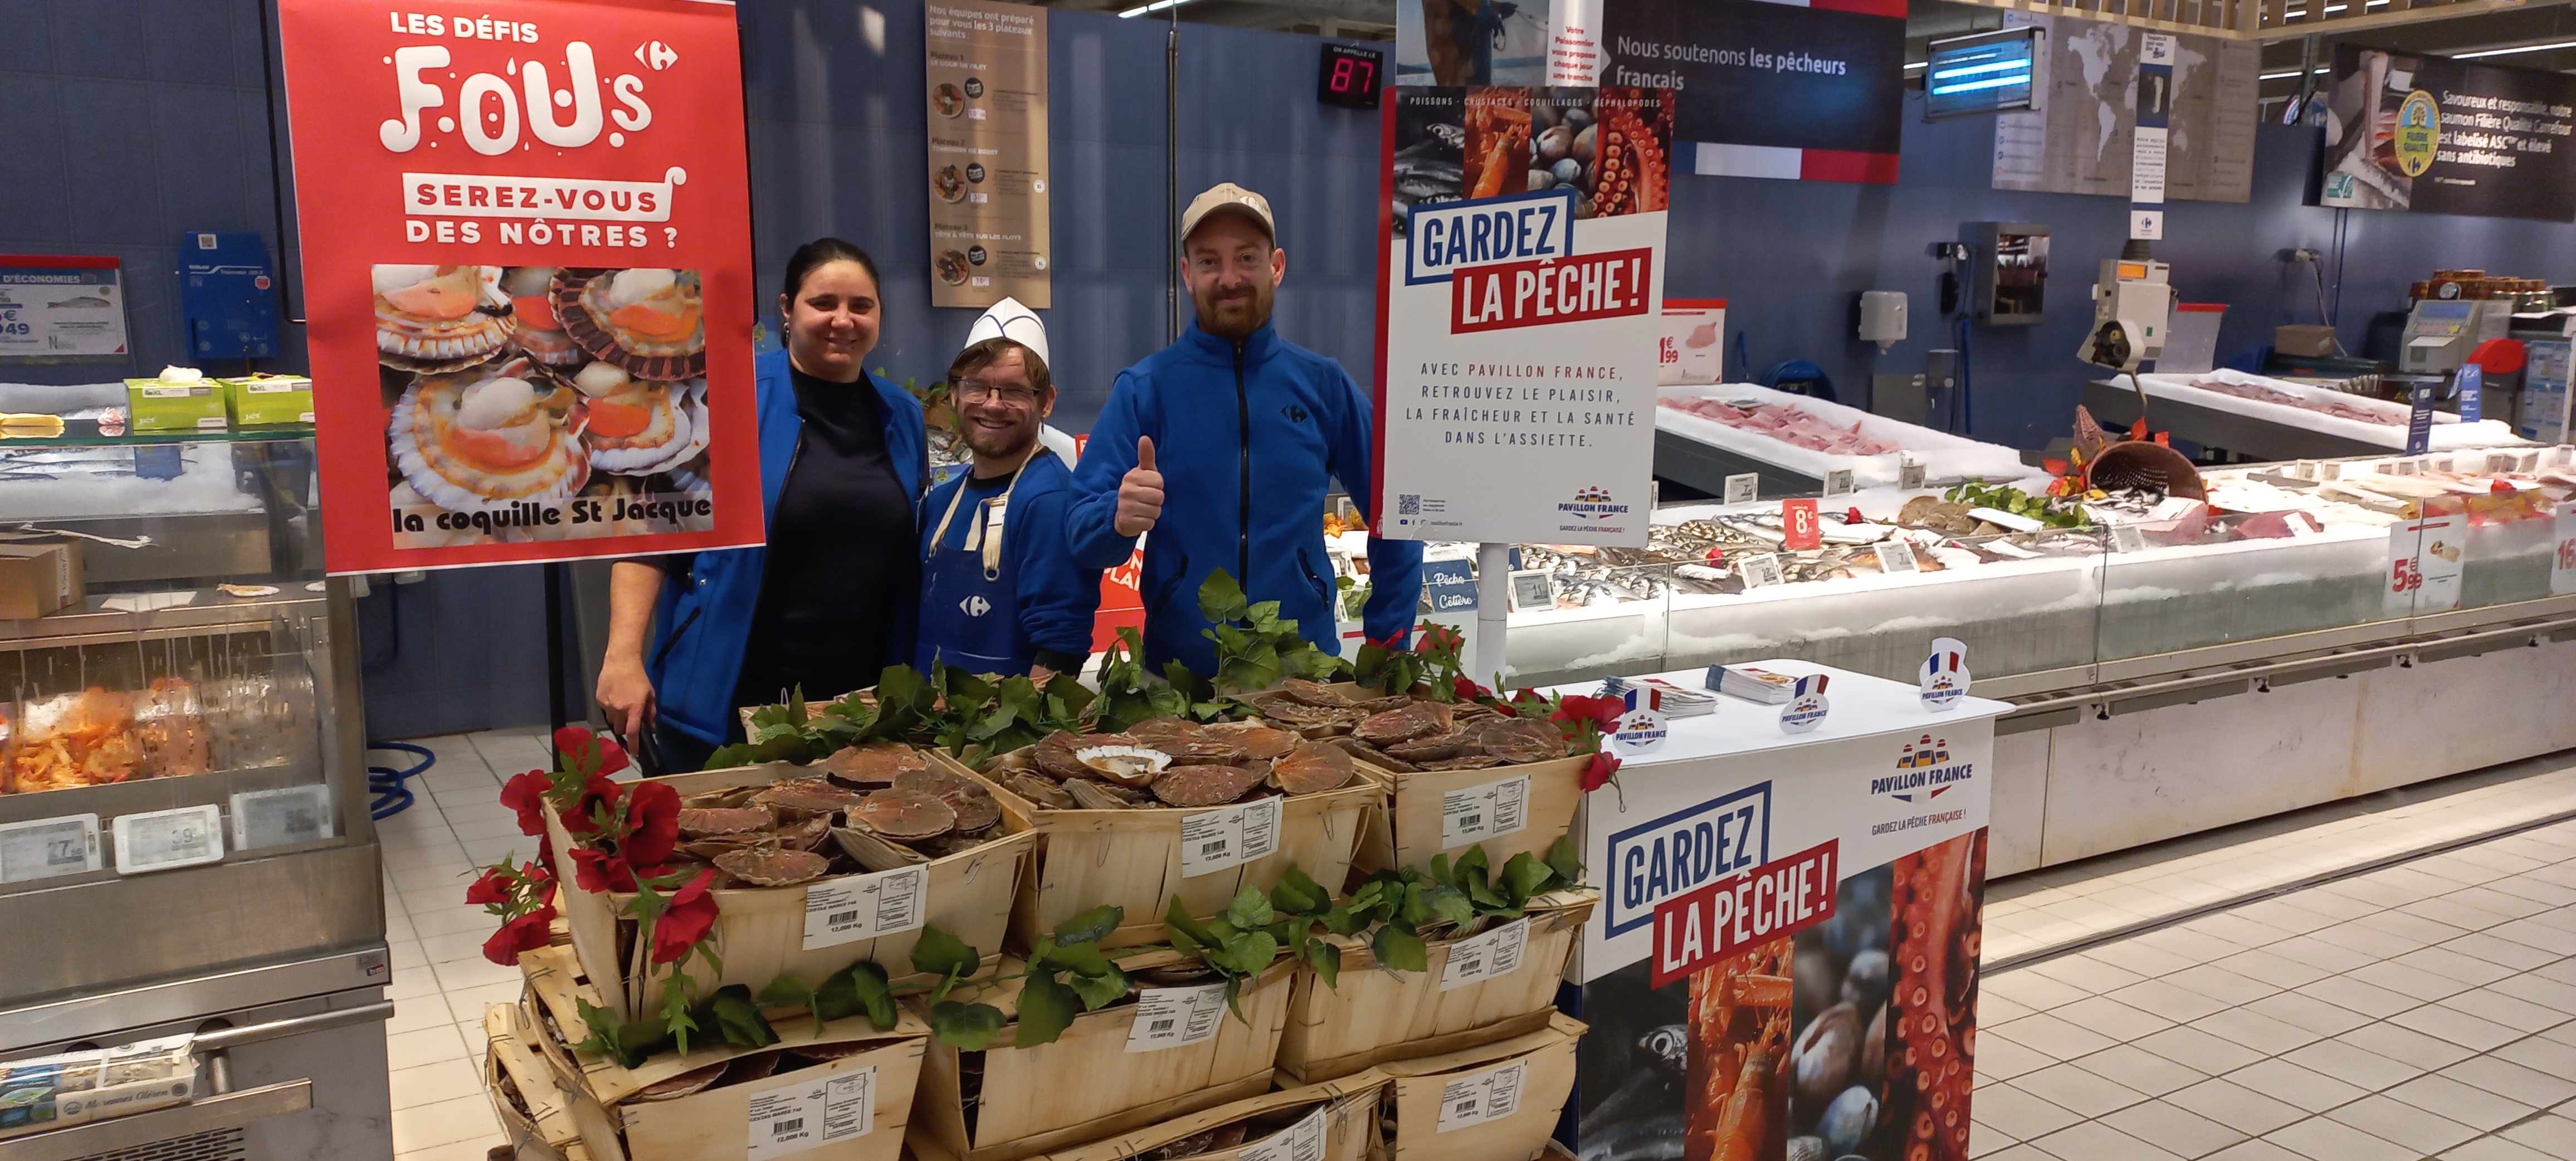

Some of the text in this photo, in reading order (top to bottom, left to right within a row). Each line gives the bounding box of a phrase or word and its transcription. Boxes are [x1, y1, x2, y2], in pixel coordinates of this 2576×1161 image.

[930, 6, 1035, 26] Nos équipes ont préparé
[390, 12, 539, 43] LES DÉFIS
[930, 18, 1032, 35] pour vous les 3 plateaux
[930, 29, 966, 38] suivants
[1565, 26, 1584, 35] Votre
[1555, 36, 1594, 47] Poissonnier
[1617, 36, 1846, 75] Nous soutenons les pêcheurs
[1554, 60, 1593, 71] chaque jour
[1330, 57, 1374, 94] 87
[379, 41, 653, 156] FOUS
[1410, 97, 1452, 106] POISSONS
[1524, 97, 1583, 107] COQUILLAGES
[2442, 90, 2487, 109] Savoureux
[2488, 96, 2497, 110] et
[2441, 113, 2474, 126] saumon
[2475, 113, 2501, 129] Filière
[2440, 131, 2452, 144] est
[2453, 130, 2489, 148] labelisé
[2517, 139, 2527, 151] et
[2436, 149, 2516, 169] sans antibiotiques
[417, 184, 657, 213] SEREZ-VOUS
[406, 217, 677, 249] DES NÔTRES ?
[1424, 205, 1557, 267] GARDEZ
[3, 274, 80, 283] D'ÉCONOMIES
[1462, 258, 1641, 325] LA PÊCHE !
[1421, 363, 1623, 381] AVEC PAVILLON FRANCE,
[1422, 386, 1620, 403] RETROUVEZ LE PLAISIR,
[1407, 407, 1635, 426] LA FRAÎCHEUR ET LA SANTÉ
[1446, 431, 1593, 447] DANS L'ASSIETTE.
[393, 497, 712, 535] la coquille St Jacque
[1558, 503, 1628, 513] PAVILLON FRANCE
[1433, 573, 1465, 587] Pêche
[1440, 594, 1473, 608] Côtière
[1922, 688, 1963, 701] PAVILLON FRANCE
[1782, 709, 1827, 723] PAVILLON FRANCE
[1616, 729, 1667, 742] PAVILLON FRANCE
[1871, 764, 1973, 794] PAVILLON FRANCE
[1872, 821, 1897, 836] GARDEZ
[1898, 819, 1906, 831] LA
[1907, 816, 1928, 830] PÊCHE
[1929, 809, 1962, 825] FRANÇAISE
[1624, 805, 1754, 909] GARDEZ
[1663, 852, 1829, 974] LA PÊCHE !
[831, 924, 851, 933] 12,000
[777, 1133, 798, 1143] 12,000
